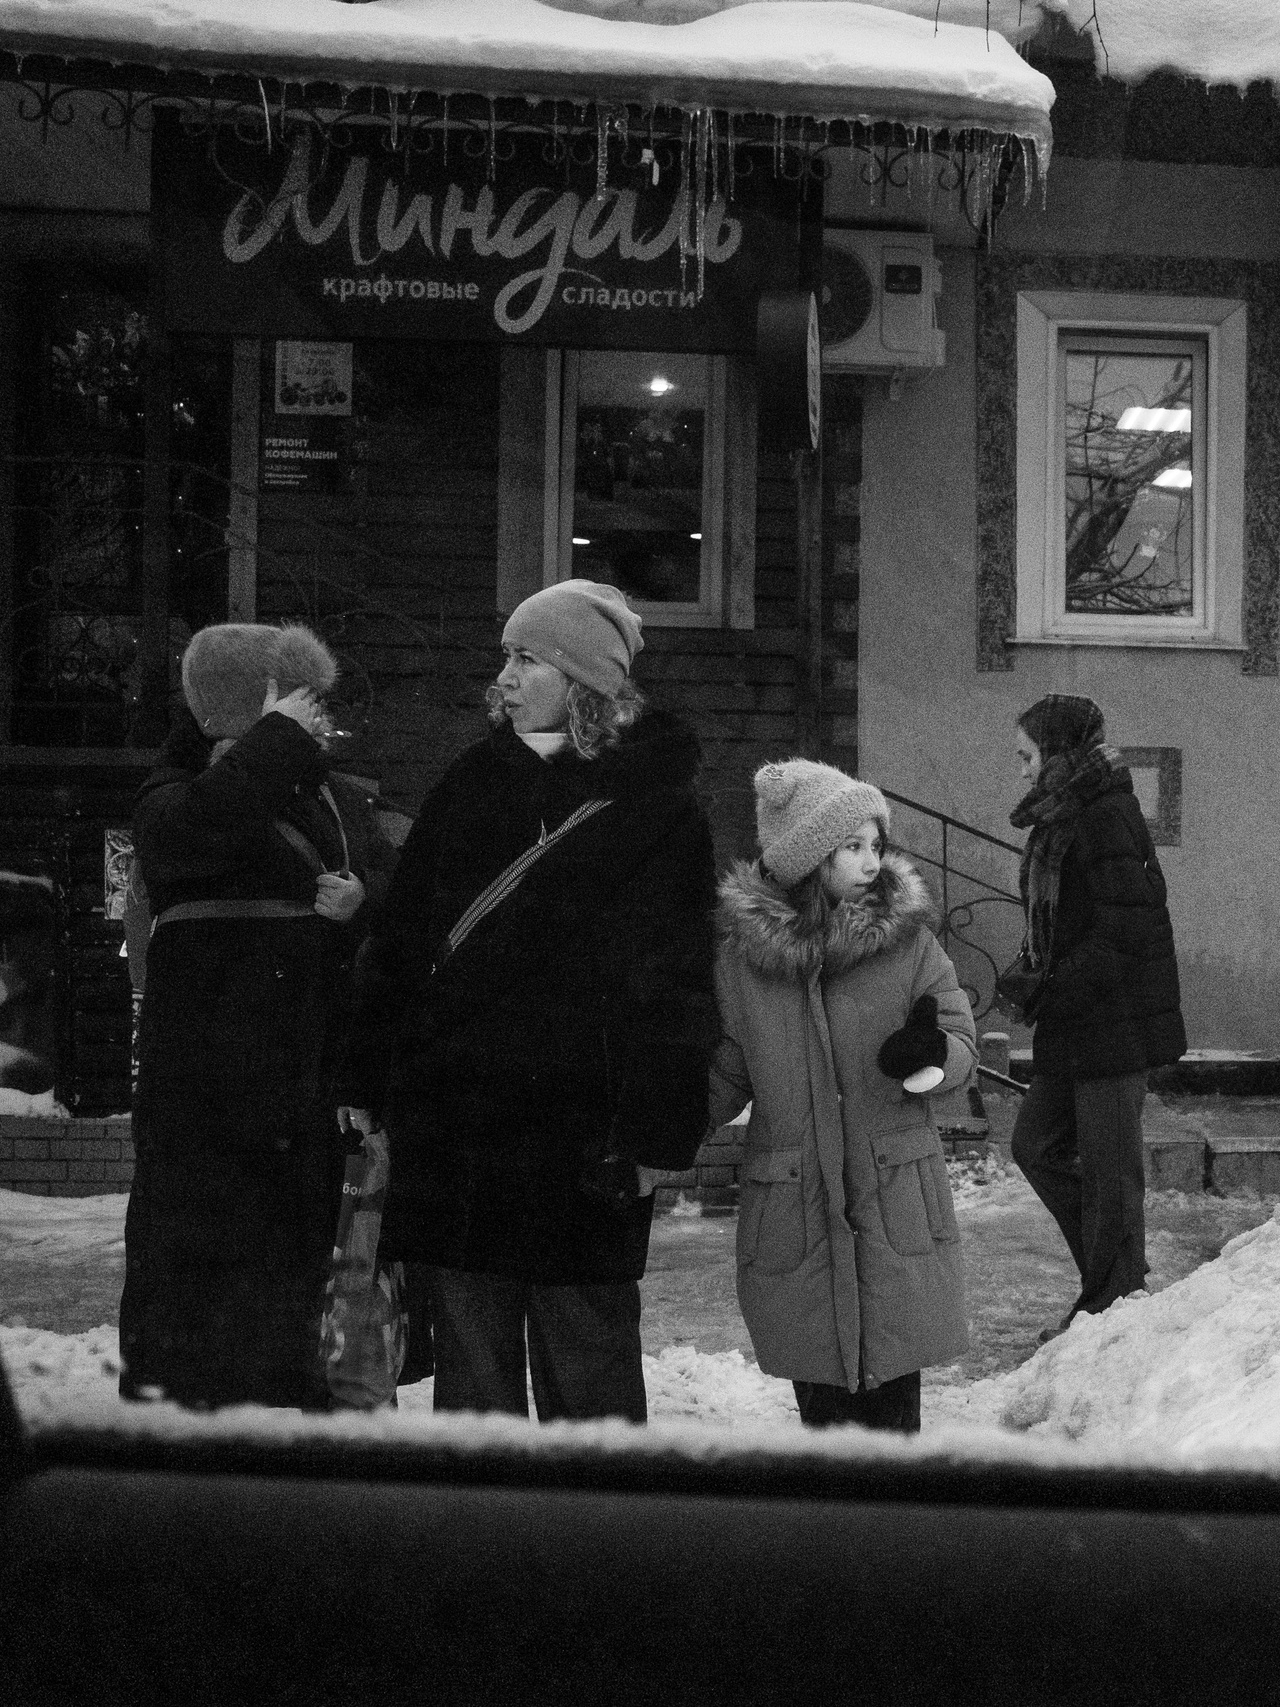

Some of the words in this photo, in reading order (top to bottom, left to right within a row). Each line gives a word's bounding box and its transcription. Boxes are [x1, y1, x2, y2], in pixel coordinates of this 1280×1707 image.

[222, 130, 743, 334] Миндаль
[322, 274, 480, 300] крафтовые
[562, 283, 697, 309] сладости
[265, 438, 309, 448] РЕМОНТ
[265, 449, 338, 460] КОФЕМАШИН
